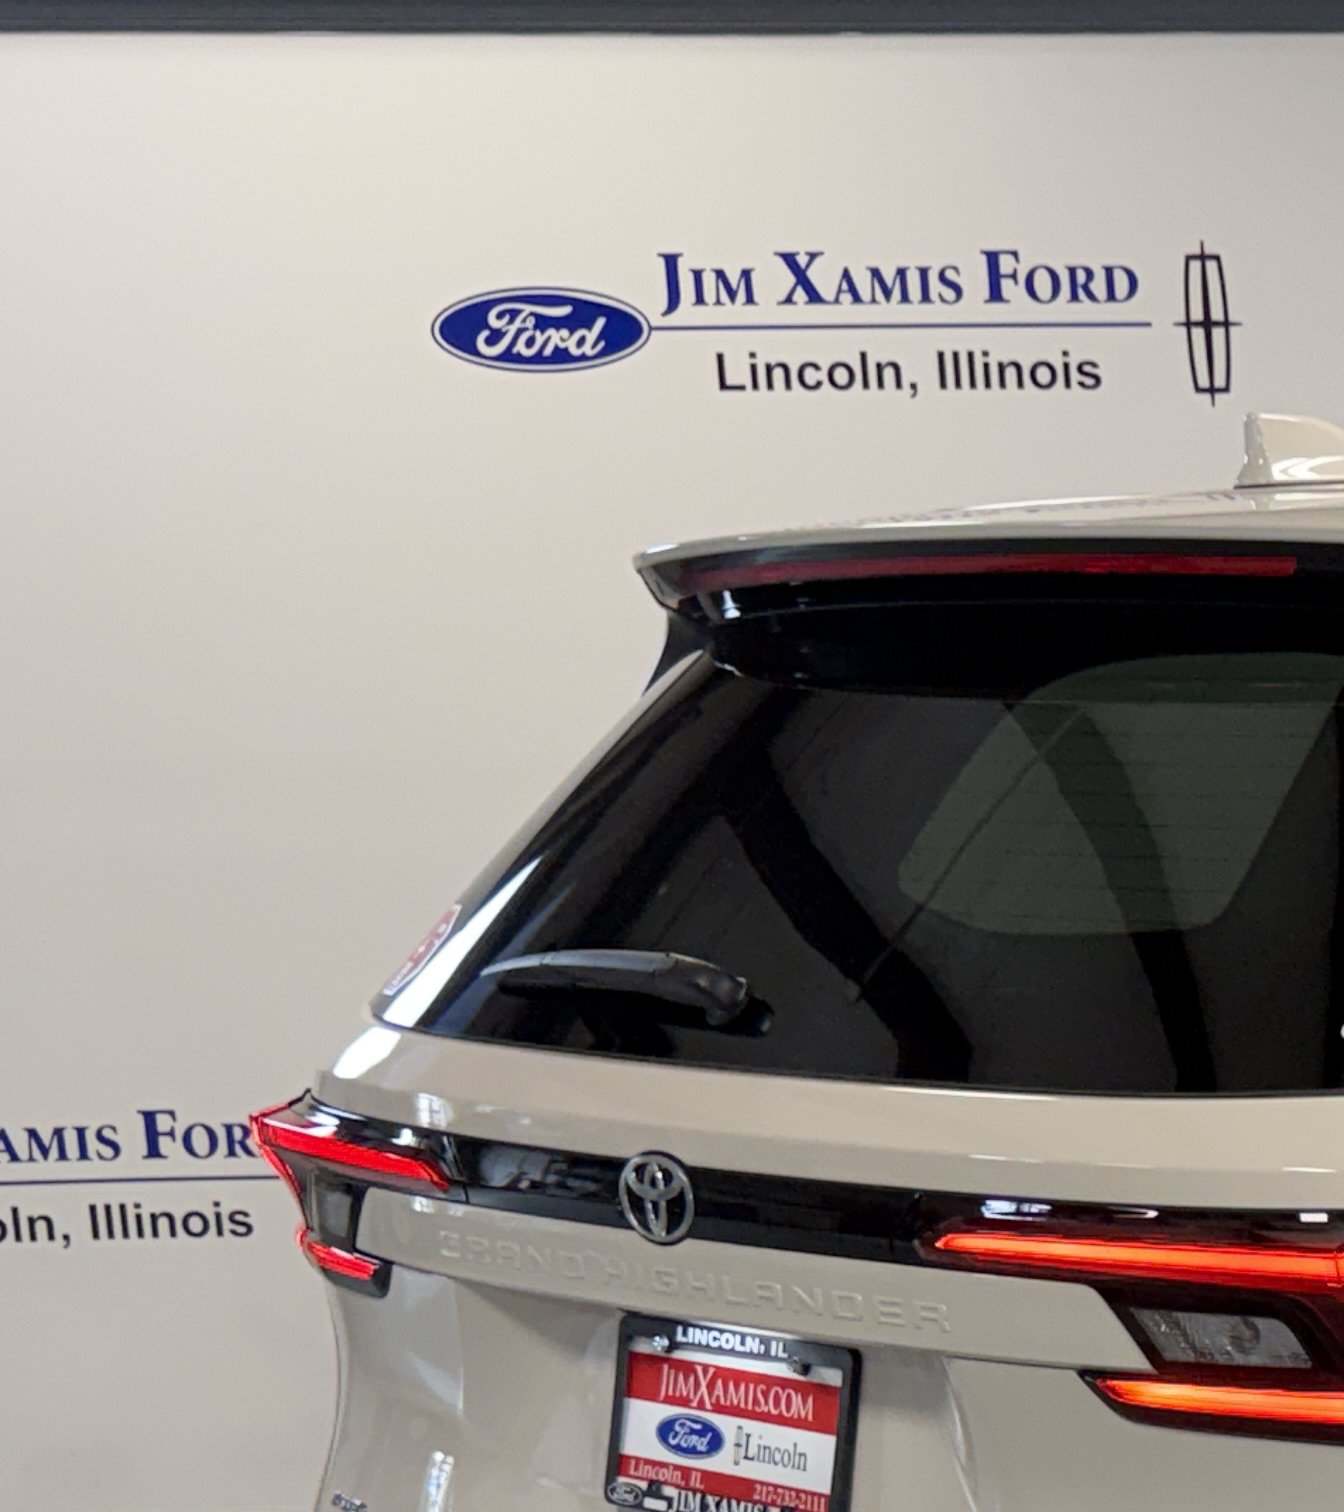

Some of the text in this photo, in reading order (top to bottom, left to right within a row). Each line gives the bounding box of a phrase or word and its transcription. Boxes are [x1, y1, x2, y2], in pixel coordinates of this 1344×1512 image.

[656, 248, 1141, 318] JIM XAMIS FORD
[475, 301, 606, 359] Ford
[716, 349, 1103, 398] Lincoln, Illinois
[136, 1108, 258, 1159] FOR
[88, 1201, 254, 1241] Illinois
[676, 1325, 789, 1360] LINCOLN, IL
[658, 1363, 814, 1422] JIMXAMIS.COM
[668, 1419, 712, 1453] Ford
[743, 1432, 809, 1473] Lincoln
